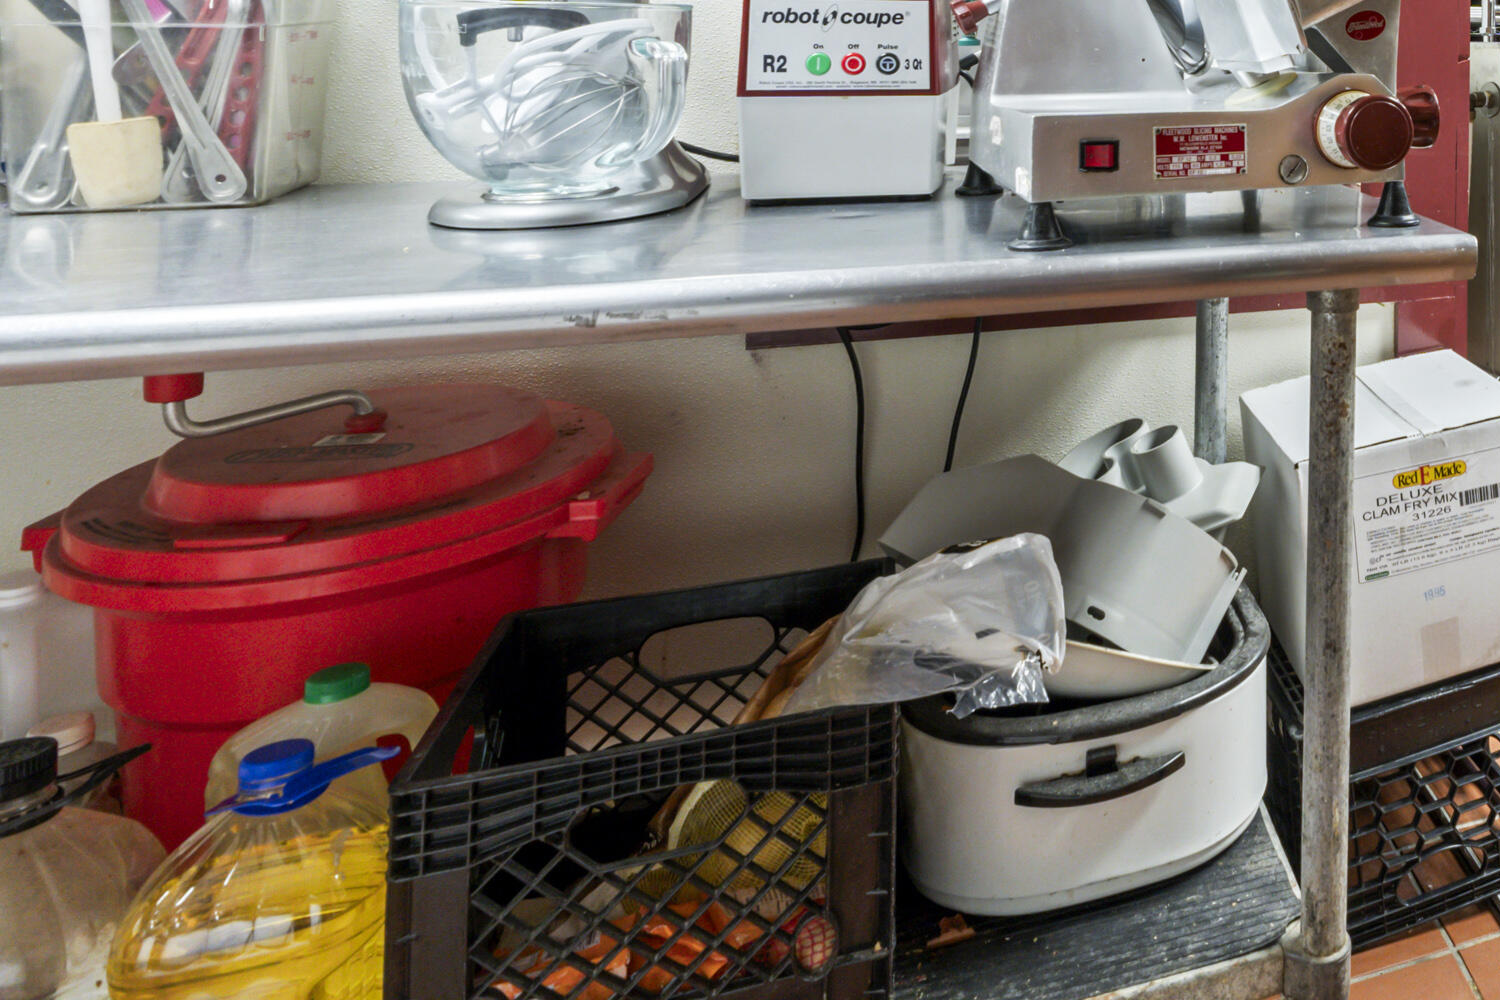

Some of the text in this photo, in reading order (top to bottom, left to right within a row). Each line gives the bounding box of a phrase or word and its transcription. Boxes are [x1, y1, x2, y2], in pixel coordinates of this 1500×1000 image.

[762, 7, 904, 28] robot coupe
[762, 54, 788, 73] R2
[904, 59, 923, 70] 3 Qt
[1397, 462, 1462, 488] Red E Made
[1362, 491, 1458, 521] CLAM FRY MIX
[1376, 484, 1443, 507] DELUXE
[1412, 506, 1452, 521] 31226
